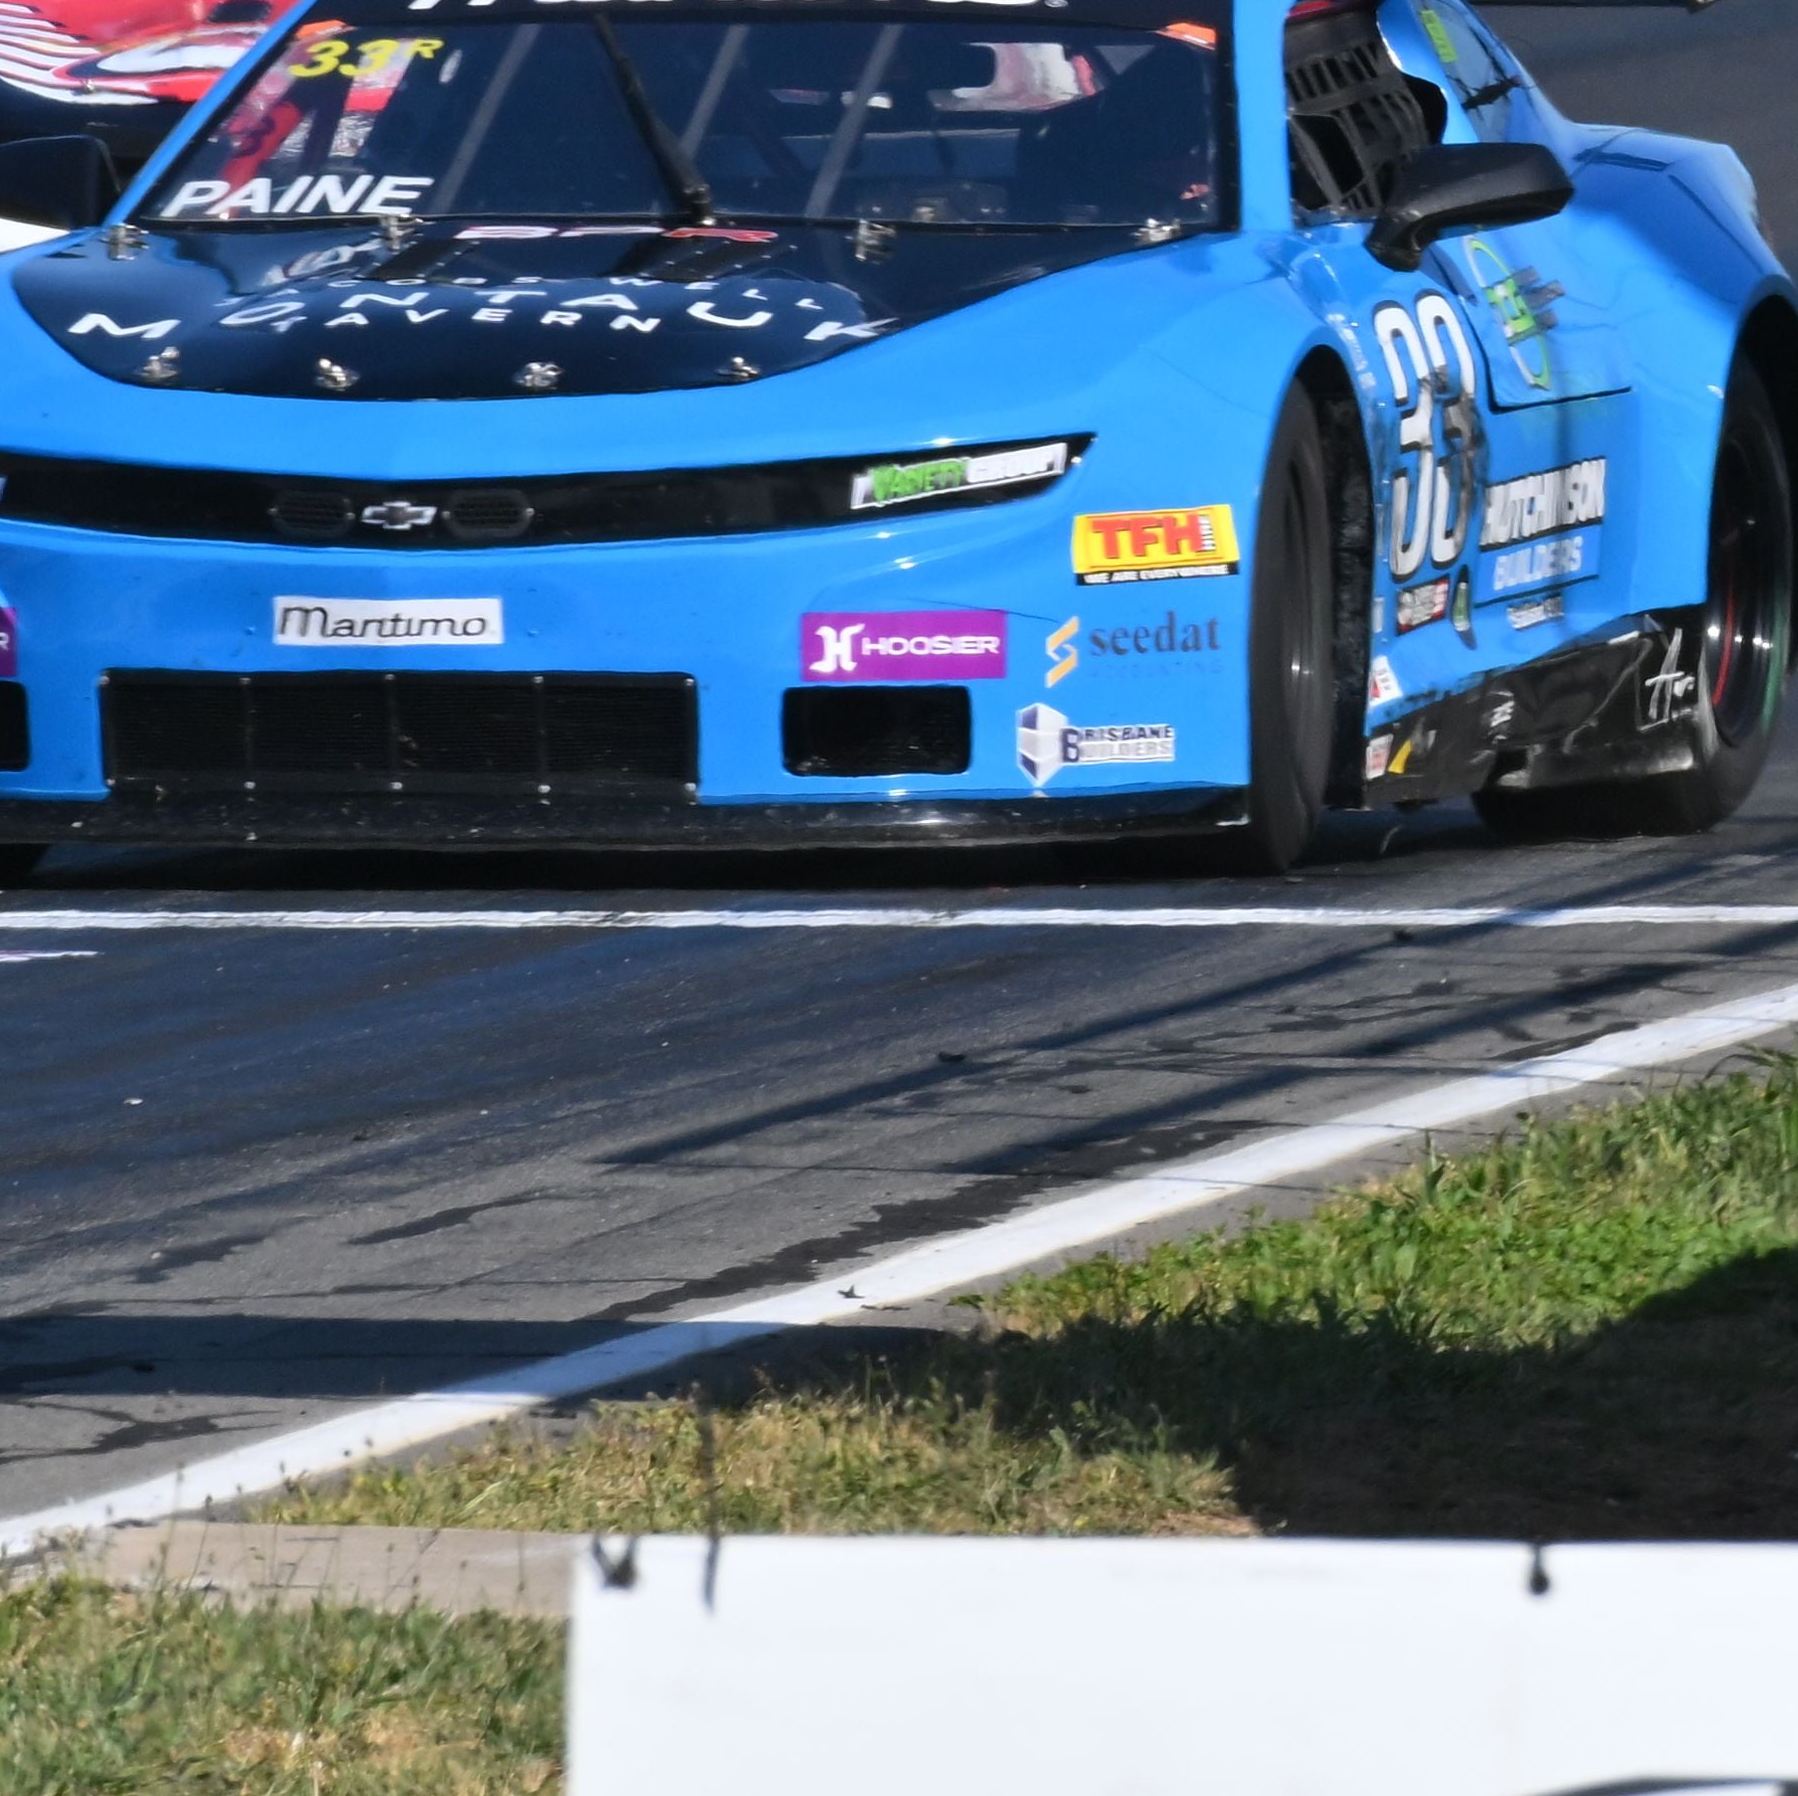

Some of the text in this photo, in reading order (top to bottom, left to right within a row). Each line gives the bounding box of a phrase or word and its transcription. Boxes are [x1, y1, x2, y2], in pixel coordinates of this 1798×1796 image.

[159, 174, 435, 218] PAINE
[67, 290, 897, 342] MONTAUK
[269, 307, 661, 334] TAVERN
[1091, 513, 1203, 559] TFH
[280, 606, 487, 638] Maritimo
[1088, 610, 1221, 656] seedat
[861, 635, 1000, 656] HOOSIER
